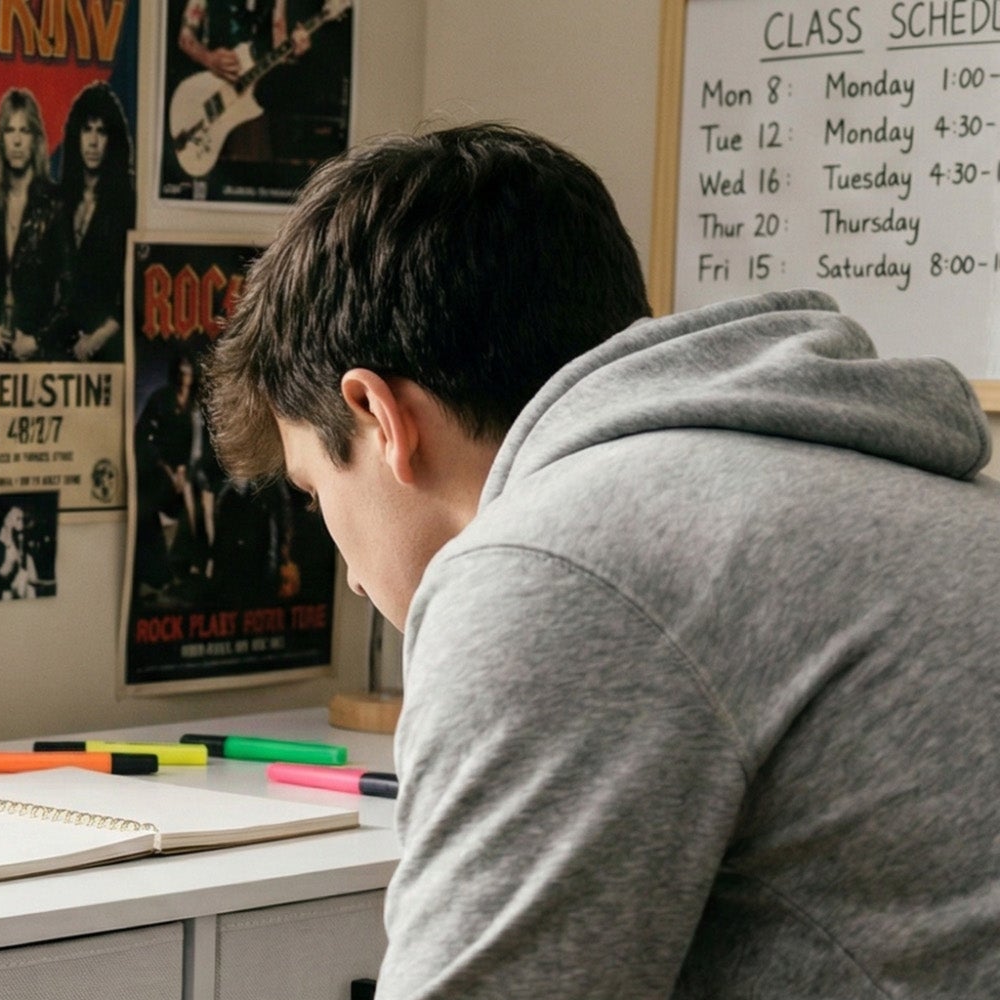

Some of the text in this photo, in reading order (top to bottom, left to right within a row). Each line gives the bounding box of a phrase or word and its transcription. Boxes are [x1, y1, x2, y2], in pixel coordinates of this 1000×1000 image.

[763, 6, 862, 50] CLASS
[701, 79, 752, 109] Mon
[826, 69, 915, 107] Monday
[701, 124, 743, 152] Tue
[759, 122, 794, 148] 12:
[825, 116, 914, 153] Monday
[699, 170, 746, 196] Wed
[759, 168, 791, 194] 16:
[823, 163, 912, 200] Tuesday
[699, 208, 920, 246] Thur 20: Thursday
[699, 254, 729, 282] Fri
[749, 254, 786, 280] 15:
[817, 254, 911, 291] Saturday
[135, 616, 183, 643] ROCK
